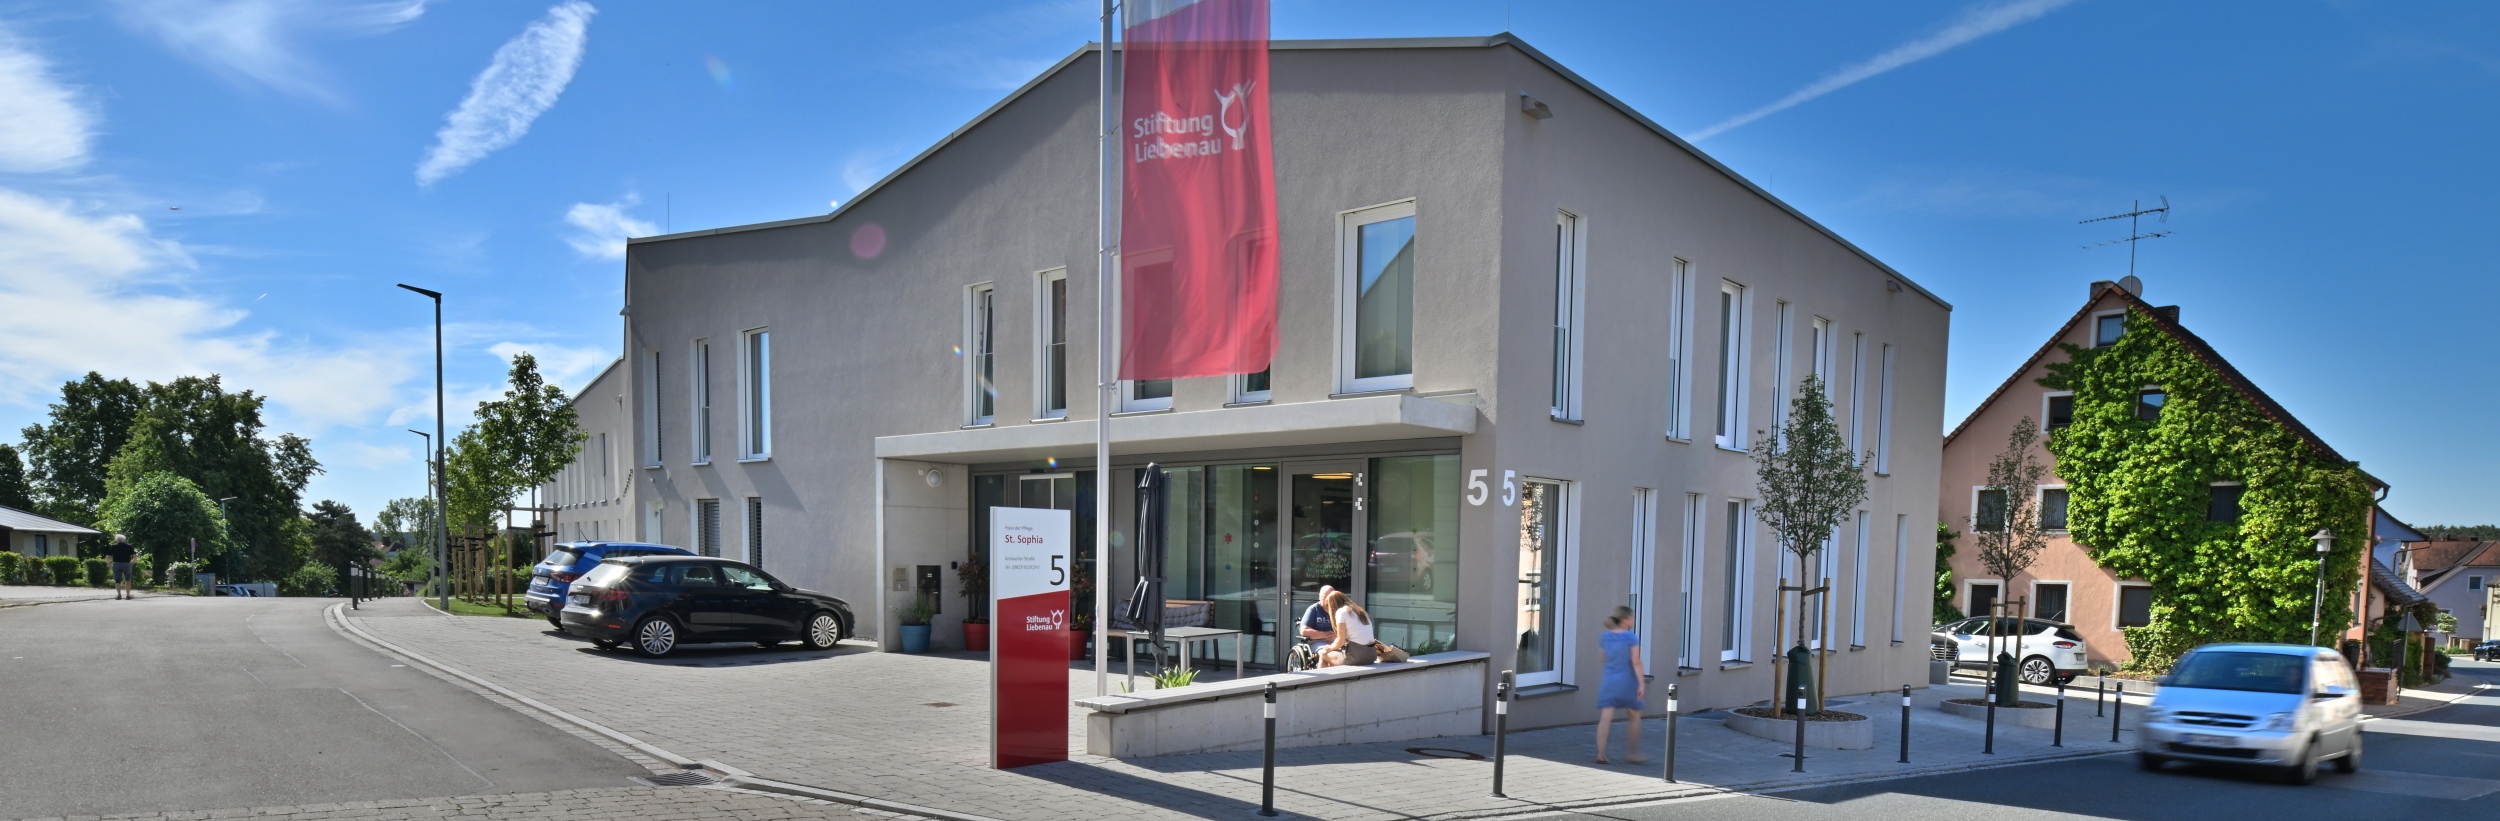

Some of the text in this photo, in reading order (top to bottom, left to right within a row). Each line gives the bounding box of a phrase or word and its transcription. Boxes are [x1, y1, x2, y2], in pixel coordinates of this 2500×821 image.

[1133, 111, 1214, 139] Stiftung
[1134, 136, 1222, 163] Liebenau
[1467, 469, 1488, 506] 5
[1503, 469, 1515, 507] 5
[1005, 534, 1043, 545] St. Sophia
[1050, 555, 1065, 586] 5
[1026, 615, 1050, 624] Stiftung
[1026, 623, 1053, 631] Liebenau
